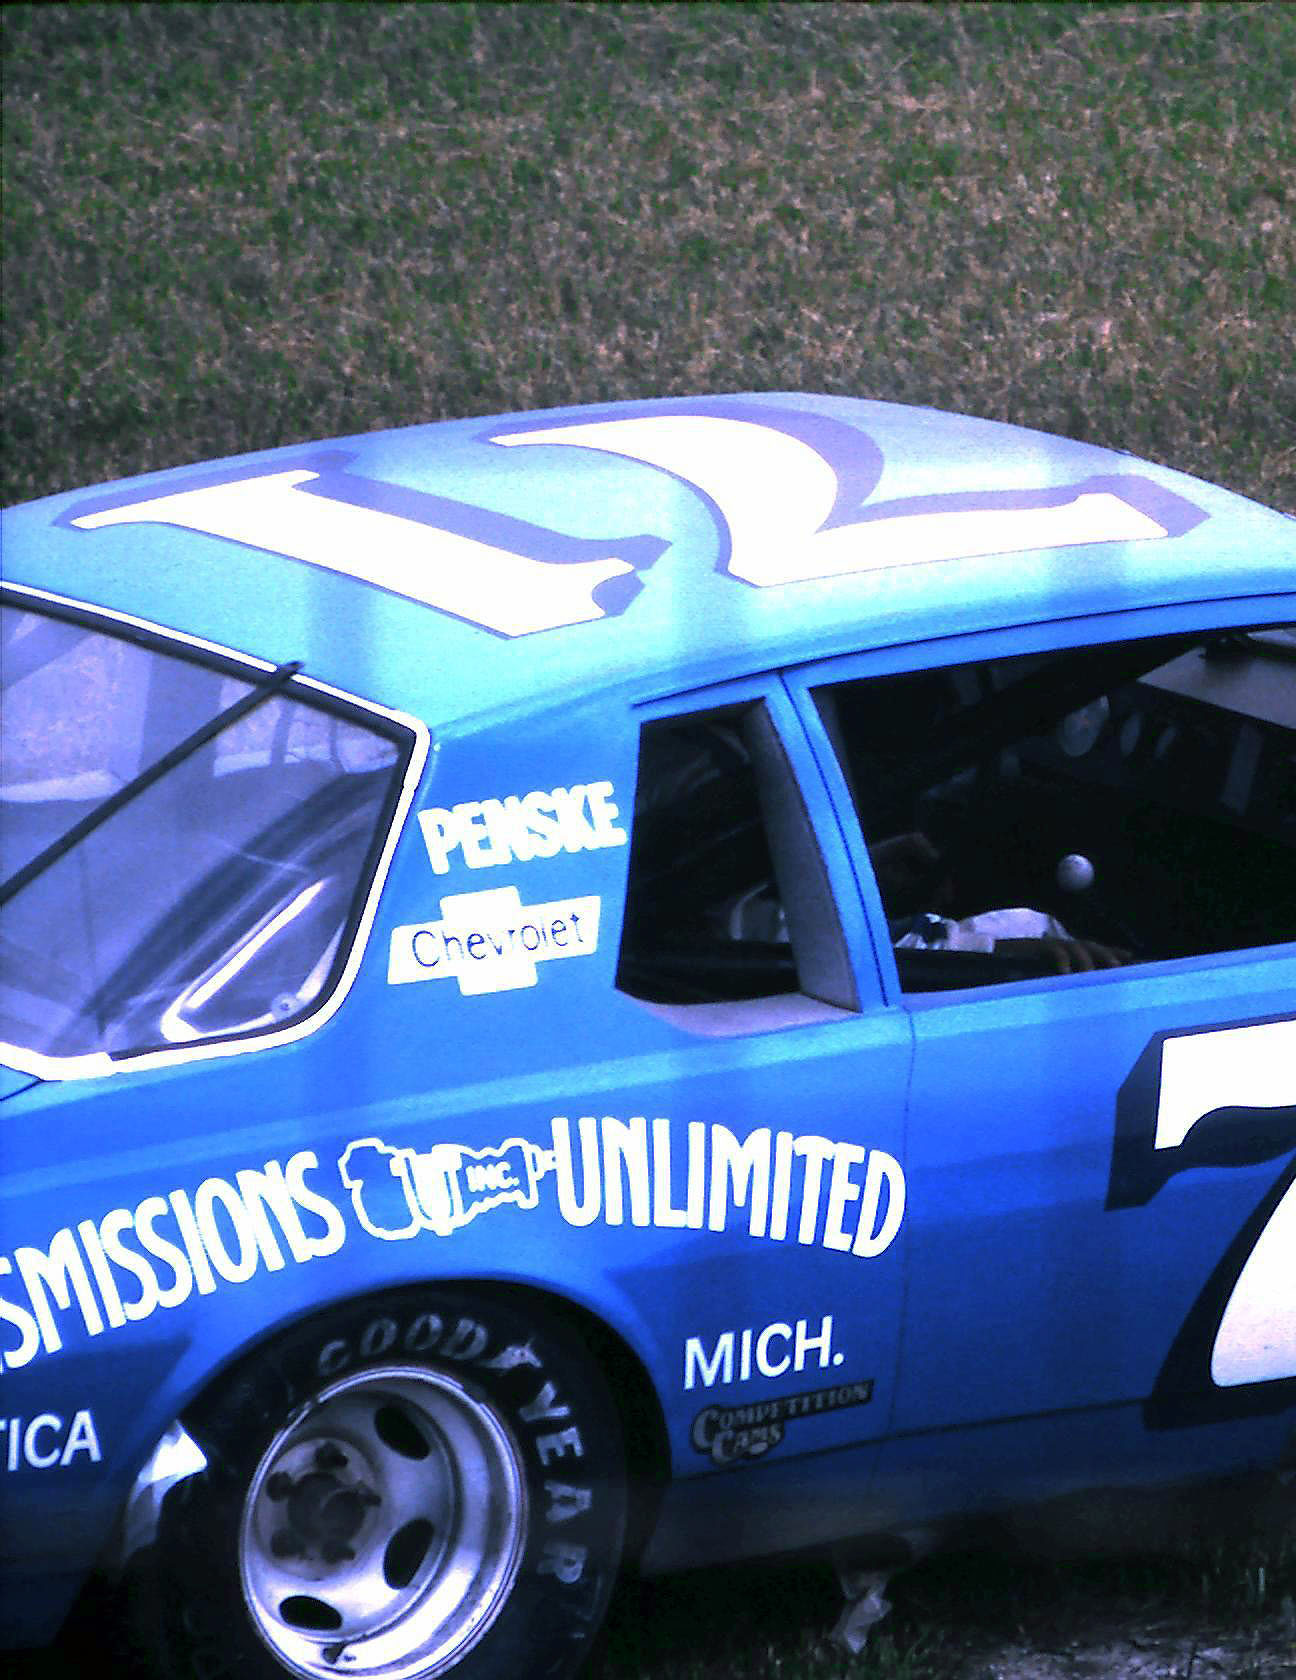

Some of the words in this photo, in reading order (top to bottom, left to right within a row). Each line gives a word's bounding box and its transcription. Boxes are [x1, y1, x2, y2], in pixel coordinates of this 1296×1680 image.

[416, 780, 628, 876] PENSKE
[411, 913, 585, 968] Chevrolet
[465, 1161, 520, 1193] INC.
[550, 1116, 907, 1258] UNLIMITED
[0, 1408, 102, 1472] ICA
[683, 1314, 845, 1390] MICH.
